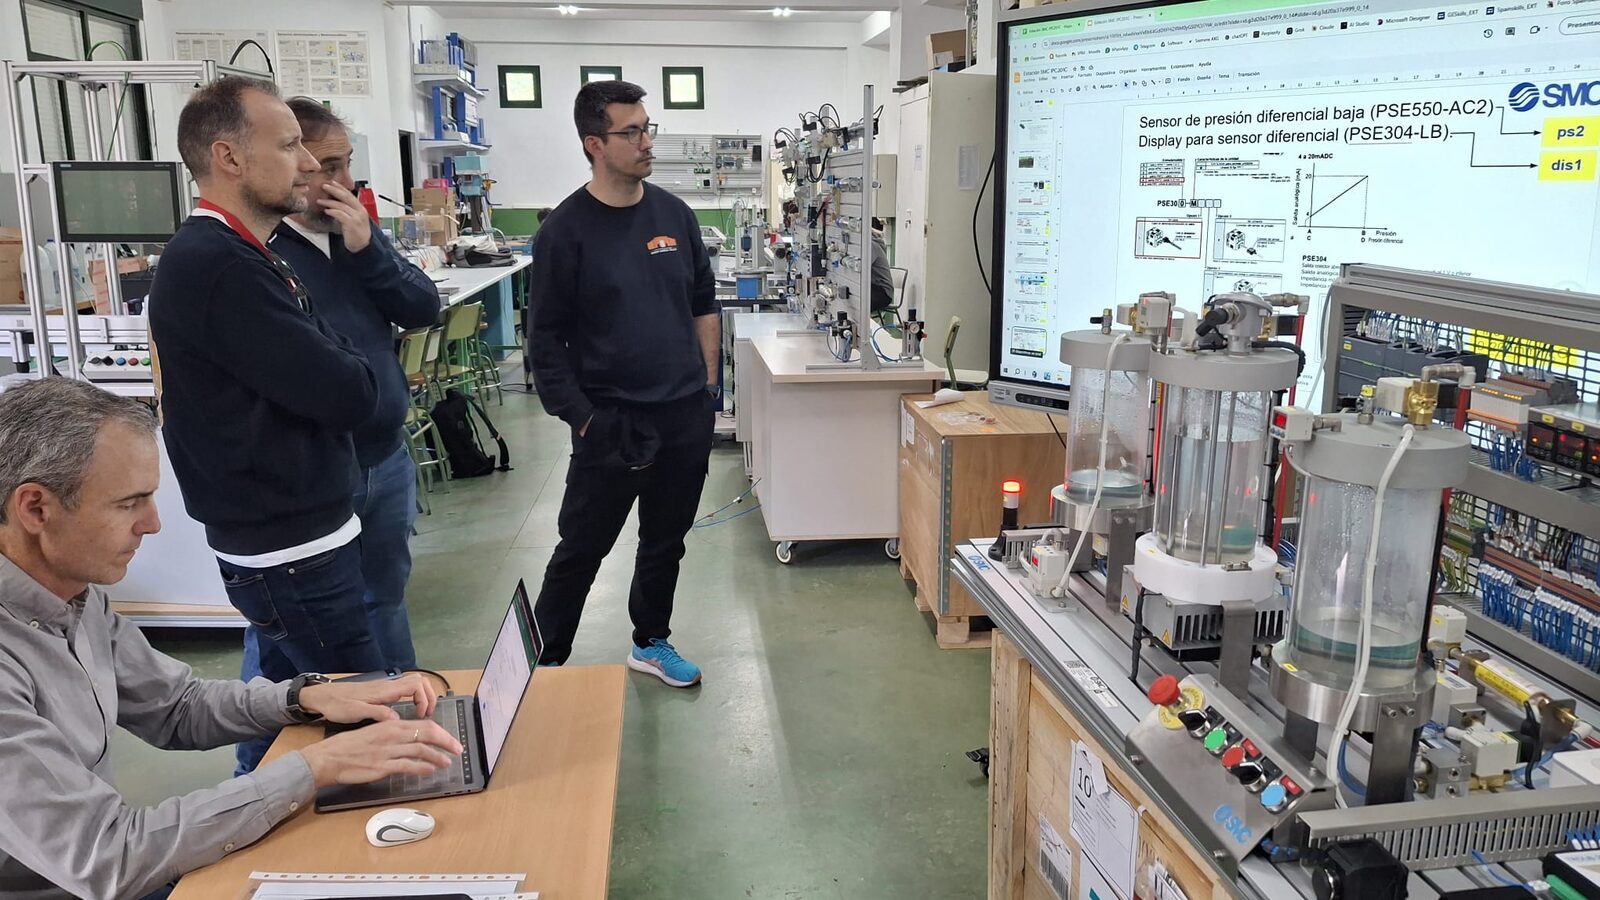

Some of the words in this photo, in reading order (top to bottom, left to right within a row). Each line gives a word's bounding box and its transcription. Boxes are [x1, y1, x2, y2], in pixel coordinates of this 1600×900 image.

[1542, 80, 1600, 108] SMC
[1140, 116, 1182, 128] Sensor
[1186, 114, 1200, 126] de
[1204, 110, 1251, 128] presión
[1256, 107, 1328, 123] diferencial
[1333, 106, 1364, 122] baja
[1370, 99, 1494, 121] (PSE550-AC2)
[1139, 134, 1182, 149] Display
[1186, 135, 1213, 148] para
[1218, 133, 1262, 145] sensor
[1266, 128, 1339, 143] diferencial
[1557, 125, 1585, 140] ps2
[1551, 159, 1582, 171] dis1
[1078, 767, 1092, 798] 10
[1225, 816, 1252, 844] SMC
